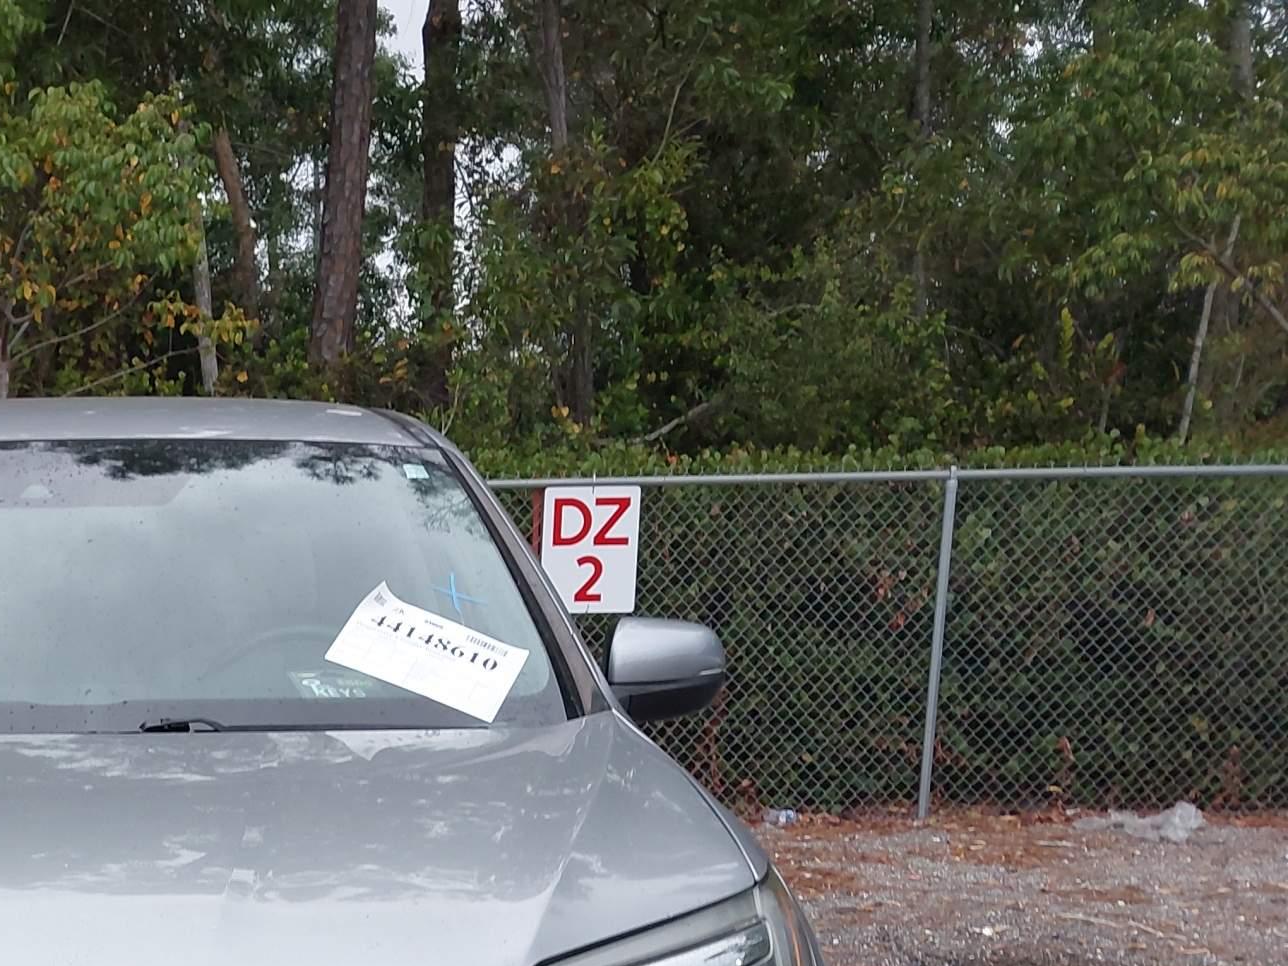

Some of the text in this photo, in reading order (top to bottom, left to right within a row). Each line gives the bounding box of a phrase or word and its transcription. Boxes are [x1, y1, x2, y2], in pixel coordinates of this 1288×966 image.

[551, 496, 632, 547] DZ
[574, 556, 603, 603] 2
[371, 615, 498, 671] 44148610
